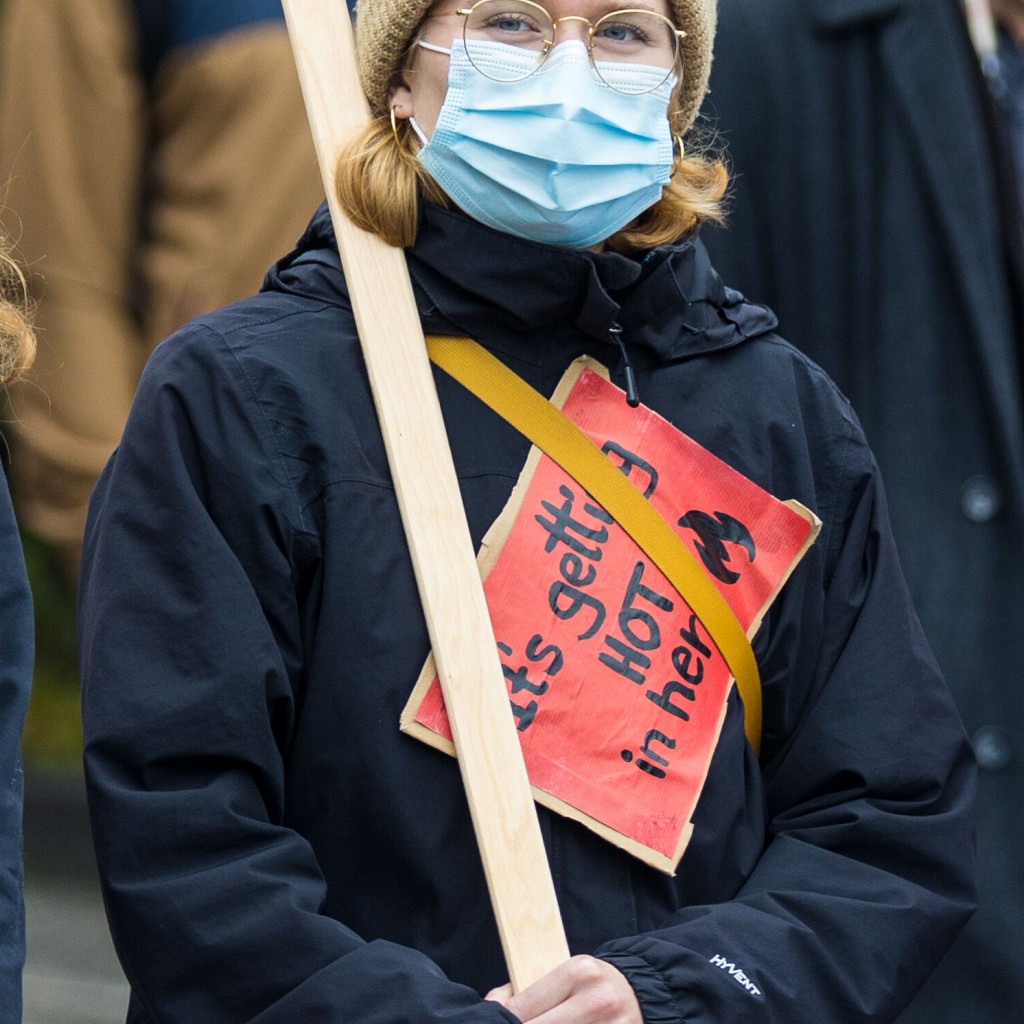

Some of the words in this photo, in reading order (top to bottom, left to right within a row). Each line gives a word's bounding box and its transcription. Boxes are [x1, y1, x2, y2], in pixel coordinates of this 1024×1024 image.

[534, 440, 659, 641] gettig
[598, 560, 675, 686] HOT
[620, 728, 677, 780] in
[709, 954, 761, 995] HYVENT
